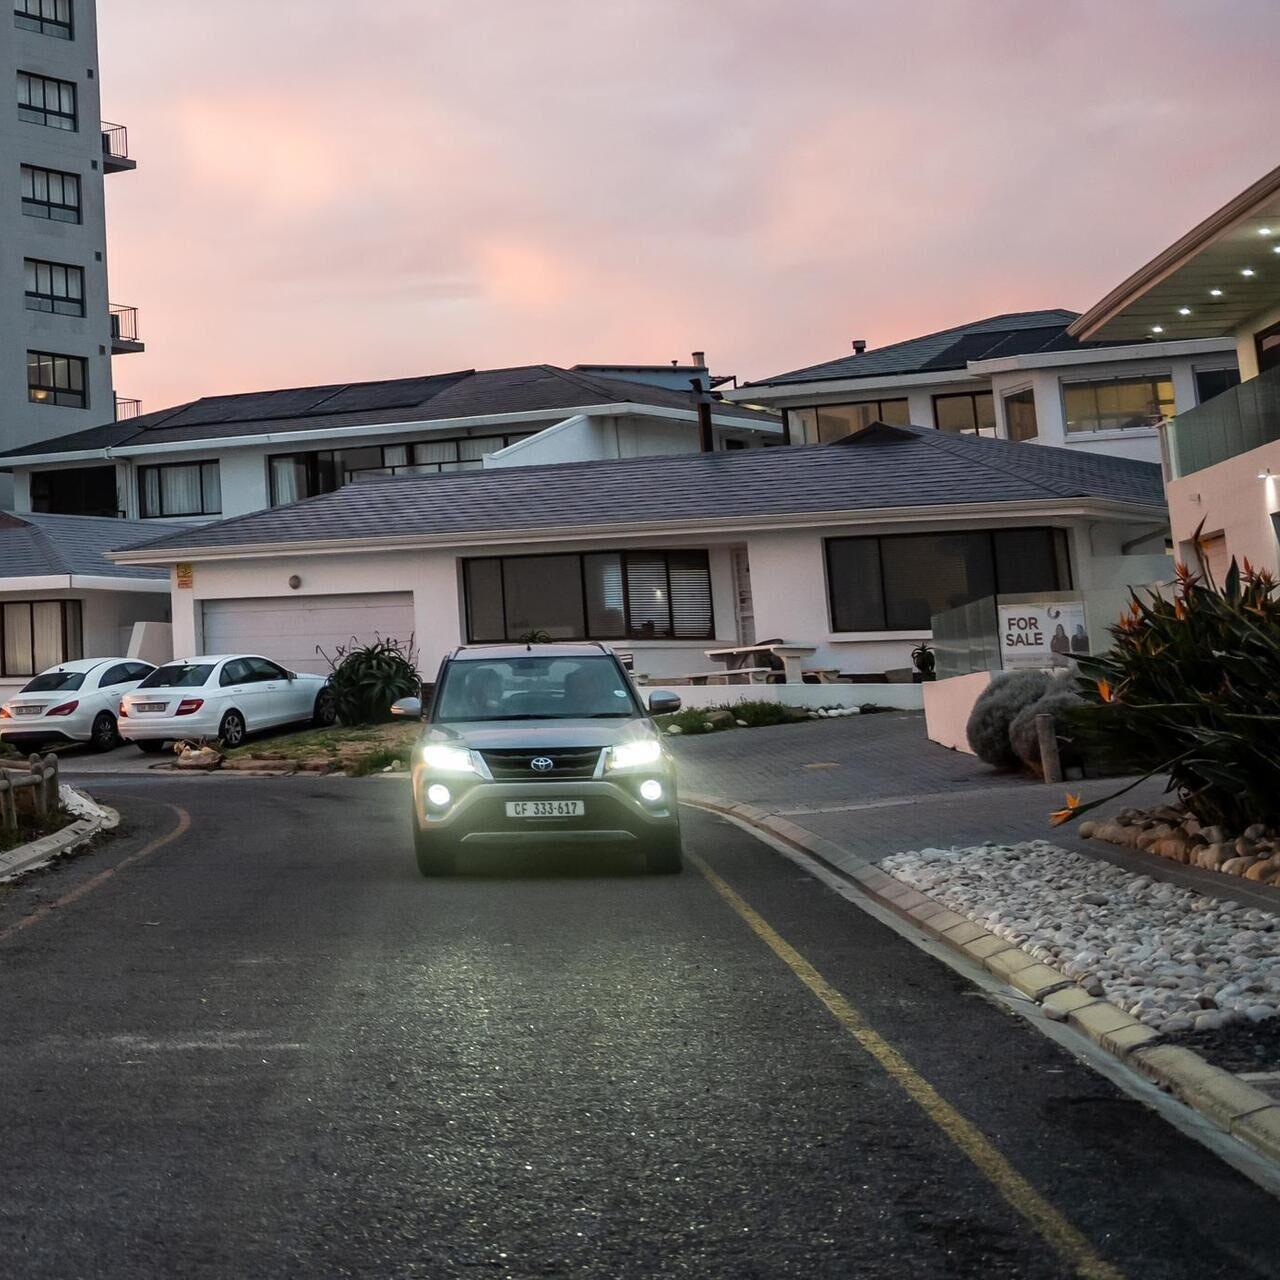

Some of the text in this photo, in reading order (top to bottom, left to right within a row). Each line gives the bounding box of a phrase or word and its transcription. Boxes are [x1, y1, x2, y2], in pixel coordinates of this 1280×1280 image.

[1007, 617, 1039, 631] FOR
[1005, 632, 1044, 647] SALE
[514, 802, 577, 815] CF 333-617
